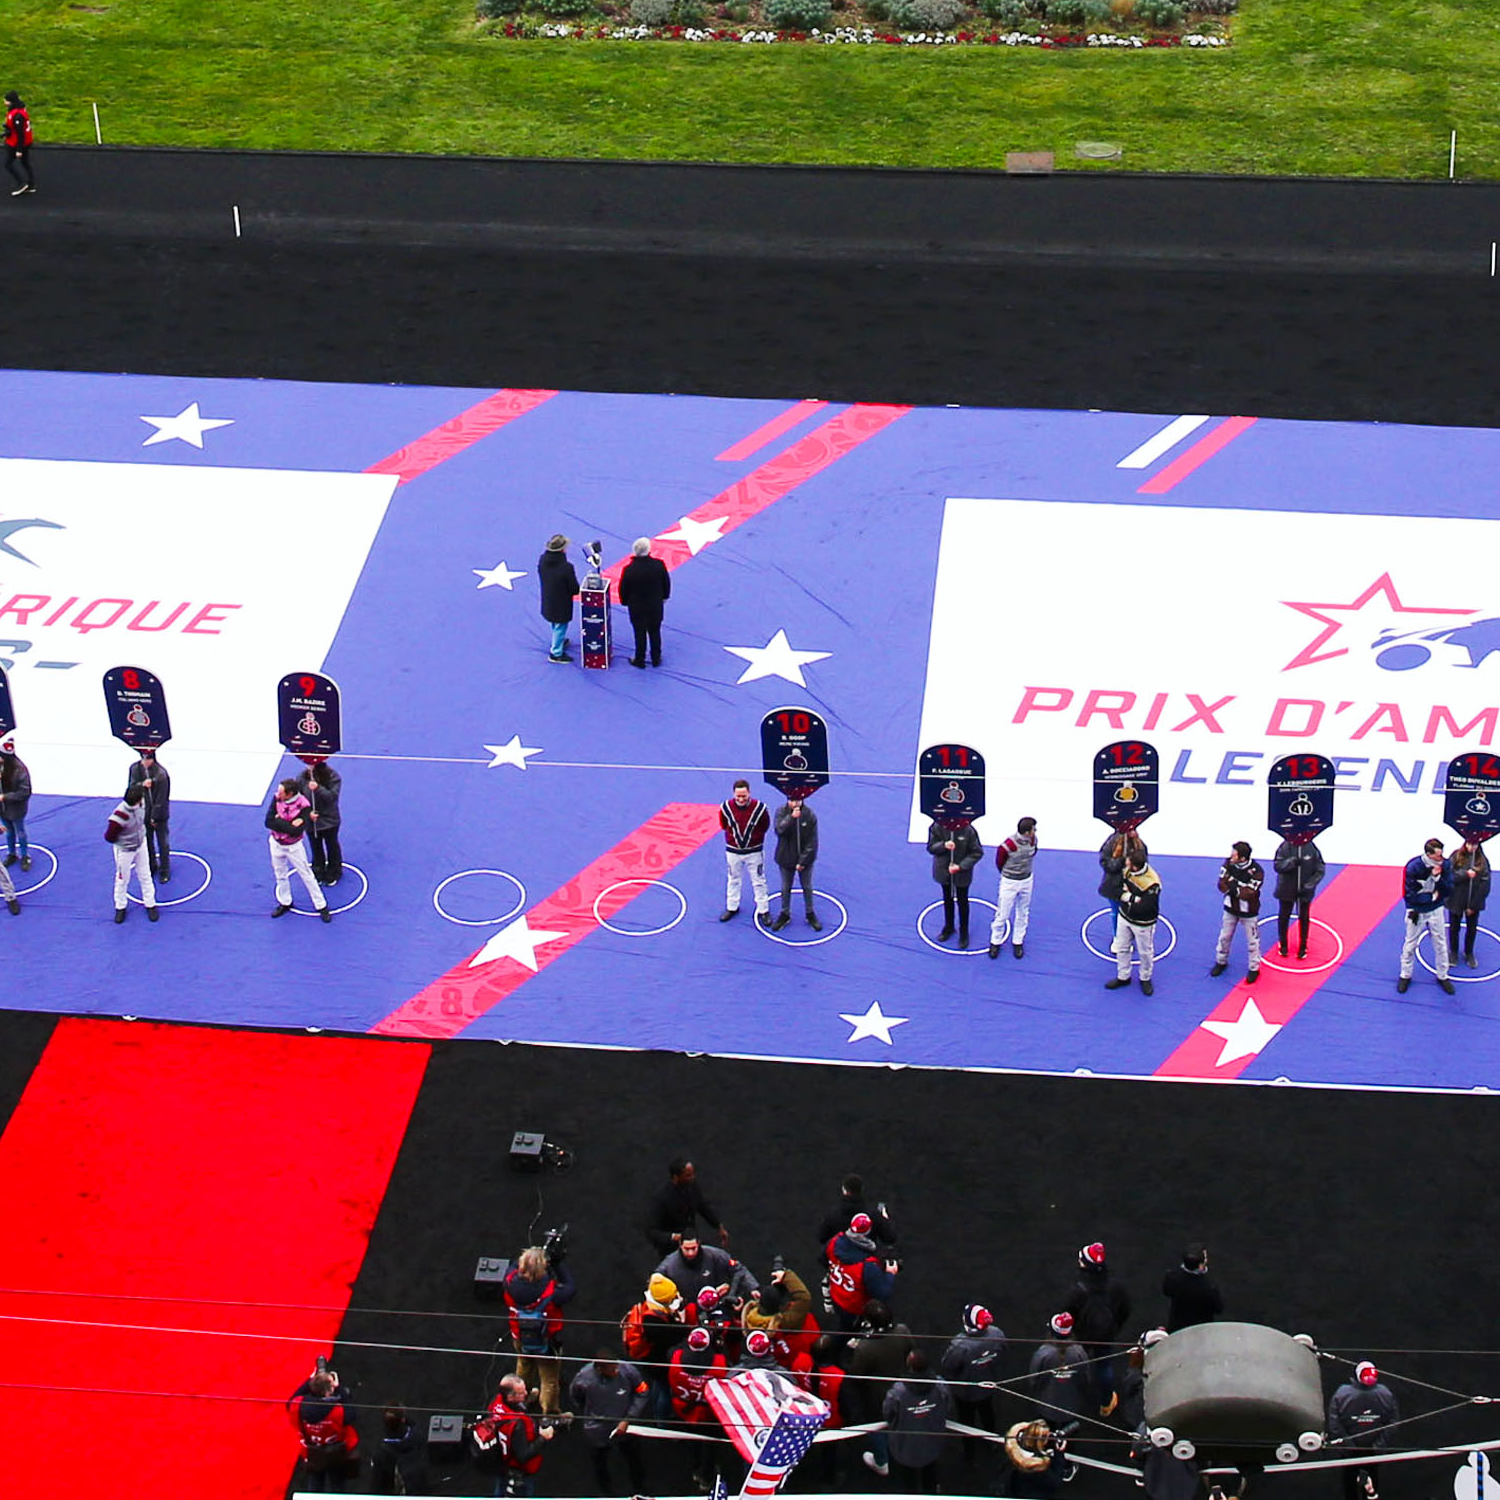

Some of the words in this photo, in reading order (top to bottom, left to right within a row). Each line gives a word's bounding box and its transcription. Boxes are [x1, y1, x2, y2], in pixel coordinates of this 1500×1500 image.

[123, 669, 140, 690] 8
[299, 676, 316, 697] 9
[1010, 685, 1238, 735] PRIX
[776, 713, 810, 733] 10
[937, 747, 969, 768] 11
[1110, 743, 1145, 765] 12
[1170, 748, 1448, 795] LEEN
[1286, 757, 1320, 778] 13
[1465, 755, 1500, 778] 14
